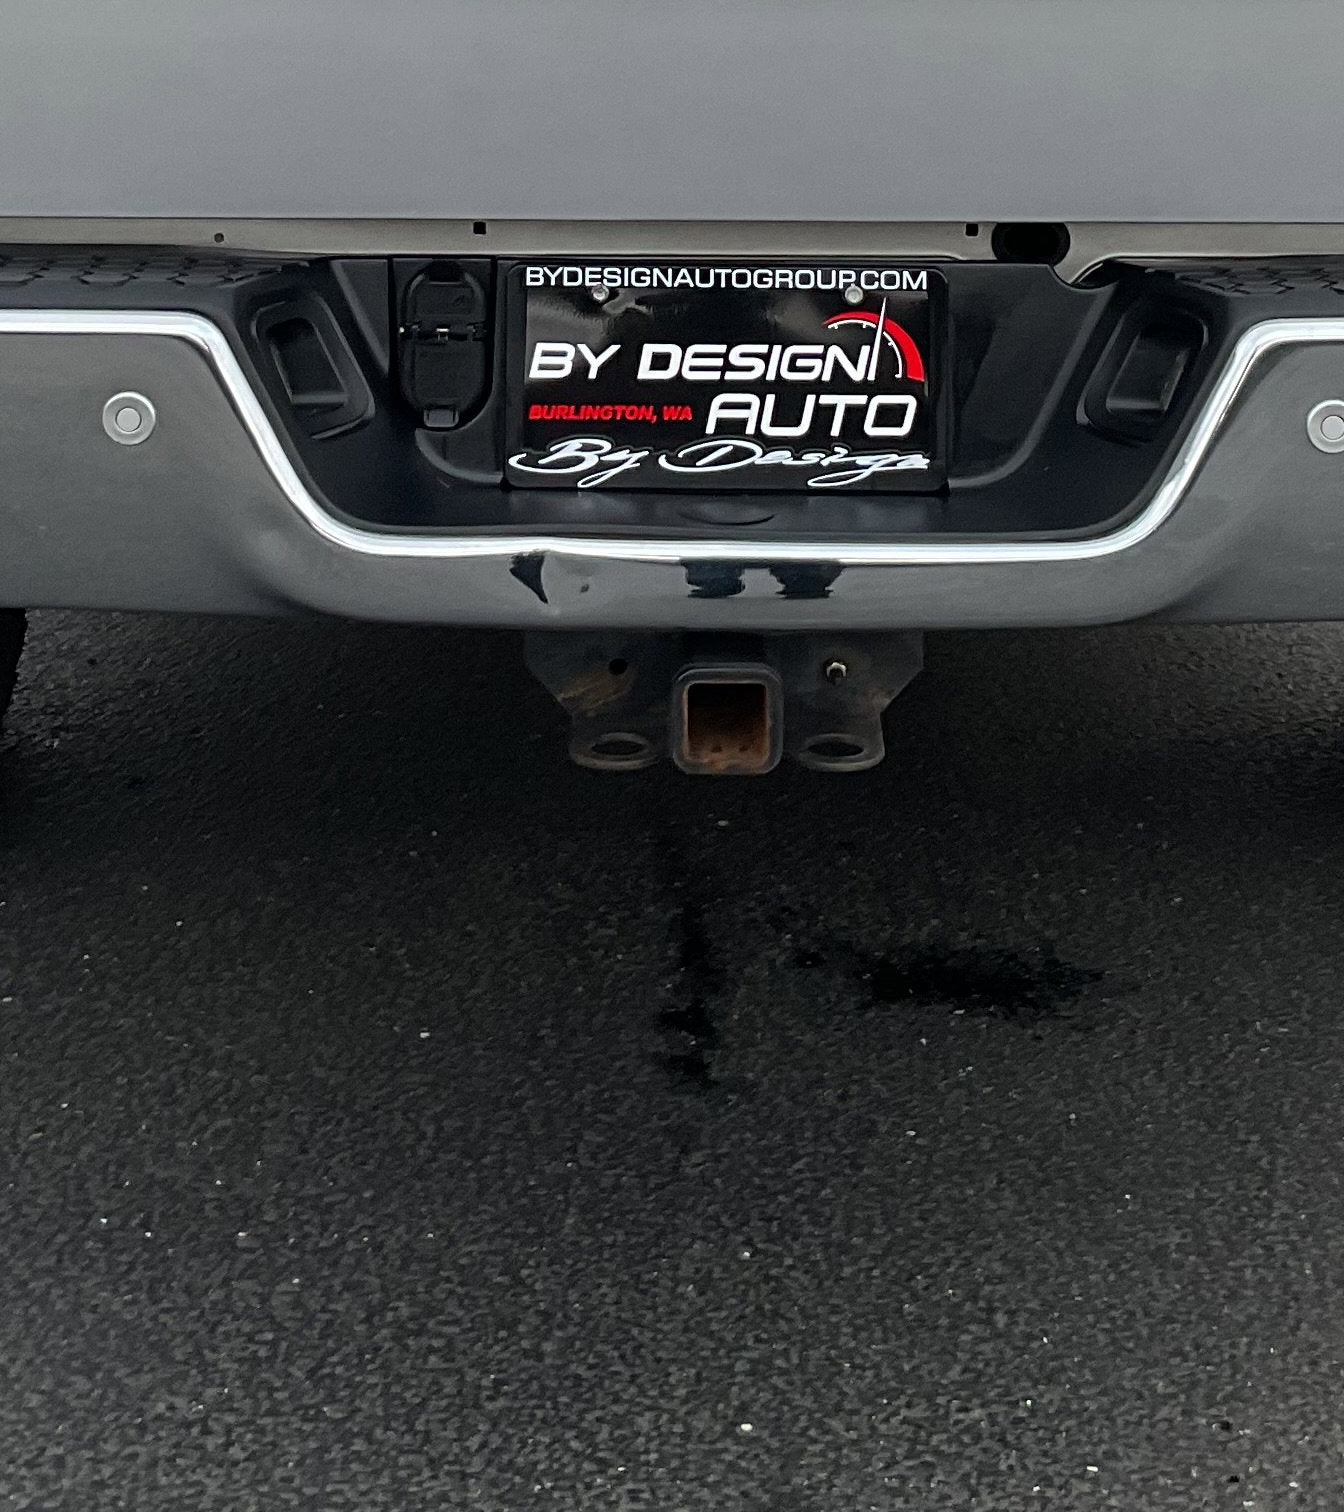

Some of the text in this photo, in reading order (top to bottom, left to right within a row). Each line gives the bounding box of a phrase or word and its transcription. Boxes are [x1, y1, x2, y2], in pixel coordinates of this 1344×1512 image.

[525, 266, 928, 290] BYDESIGNAUTOGROUP.COM
[528, 342, 873, 381] BY DESIGN
[528, 404, 693, 423] BURLINGTON, WA
[704, 393, 918, 437] AUTO
[508, 438, 650, 488] By
